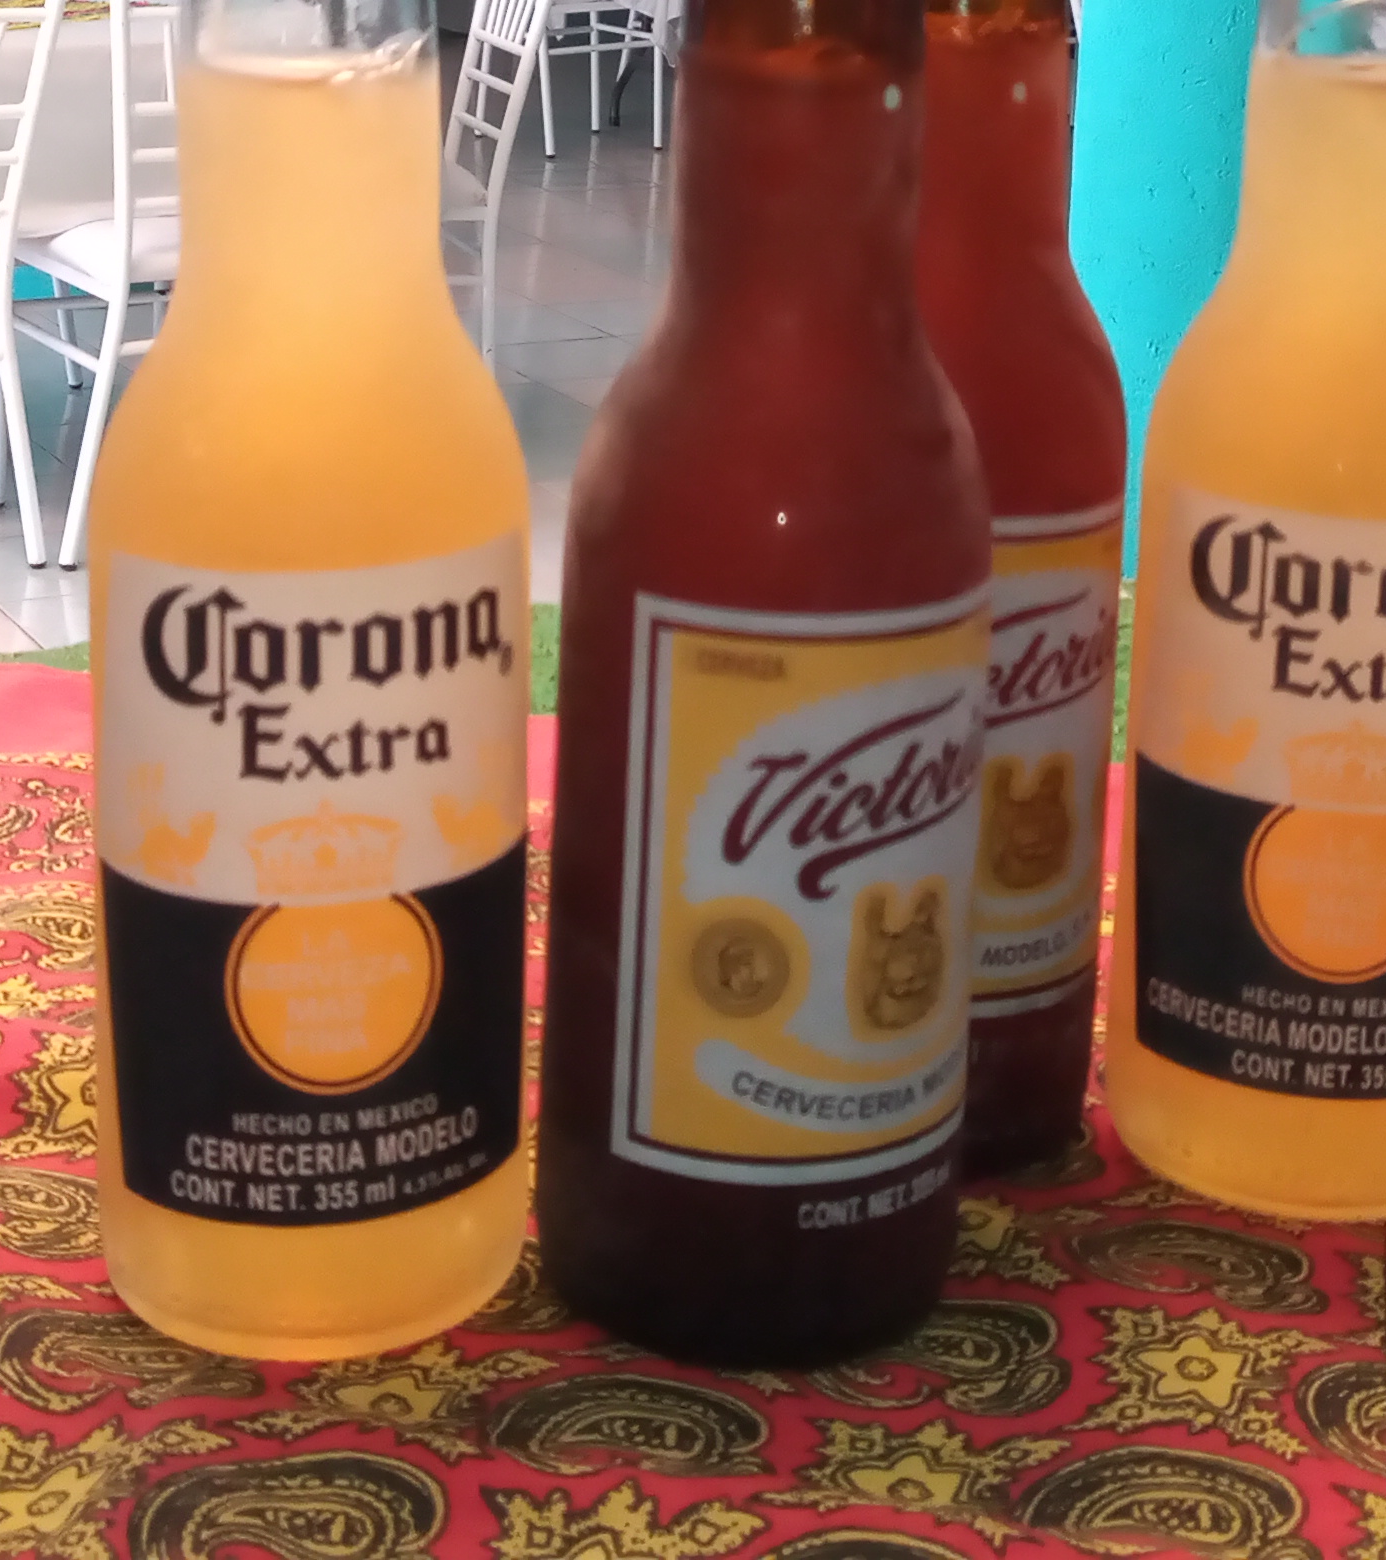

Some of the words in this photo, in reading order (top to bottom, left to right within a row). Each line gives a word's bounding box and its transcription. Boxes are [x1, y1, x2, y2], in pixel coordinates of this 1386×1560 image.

[141, 583, 515, 725] Corona
[237, 701, 452, 783] Extra
[1146, 975, 1281, 1047] CERVECERIA
[1240, 983, 1311, 1016] HECHO
[1317, 996, 1346, 1017] EN
[731, 1070, 917, 1121] CERVECERIA
[1304, 1063, 1353, 1090] NET.
[232, 1112, 312, 1136] HECHO
[319, 1111, 350, 1135] EN
[355, 1092, 439, 1132] MEXICO
[184, 1133, 366, 1178] CERVECERIA
[374, 1105, 479, 1167] MODELO
[169, 1168, 240, 1209] CONT.
[246, 1179, 308, 1213] NET.
[313, 1178, 359, 1212] 355
[365, 1174, 396, 1204] ml
